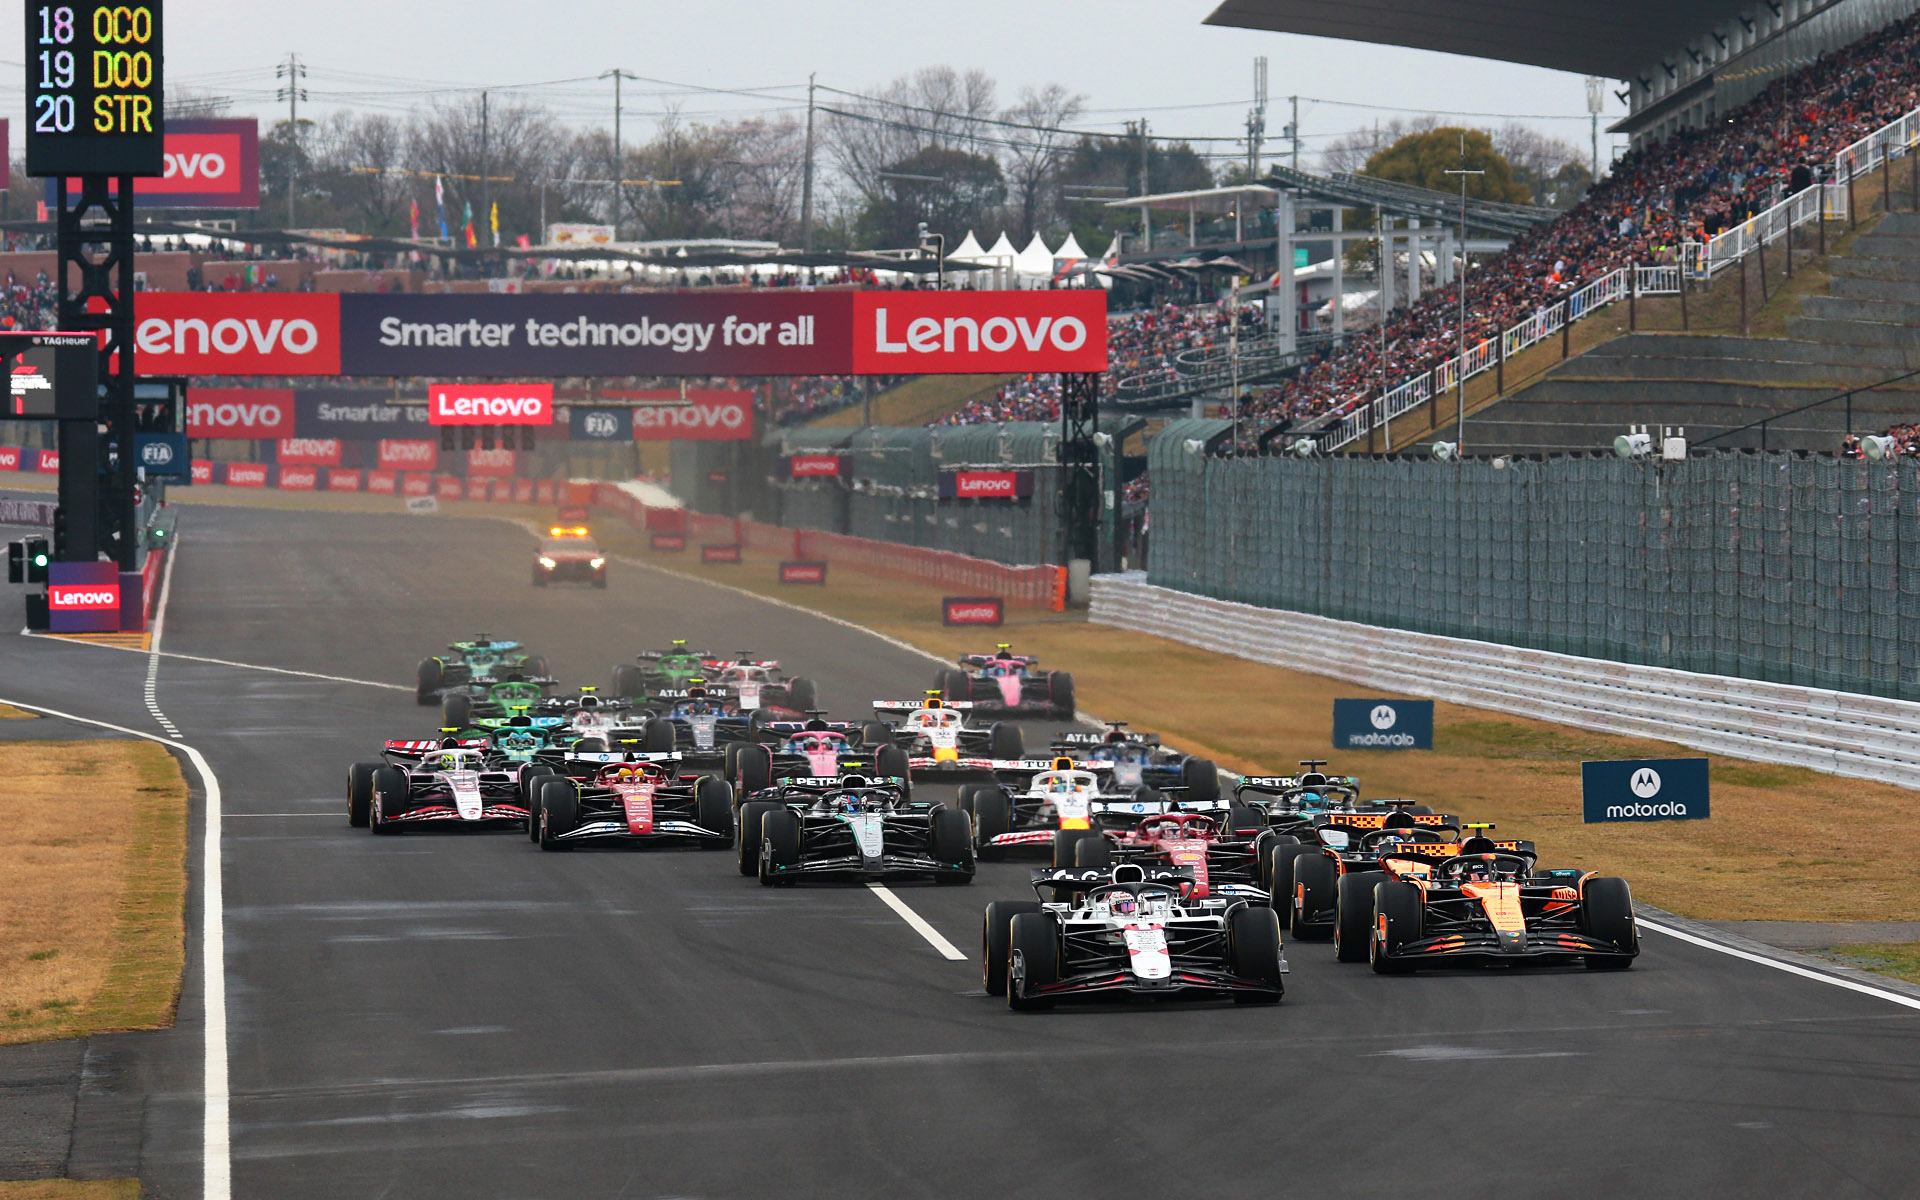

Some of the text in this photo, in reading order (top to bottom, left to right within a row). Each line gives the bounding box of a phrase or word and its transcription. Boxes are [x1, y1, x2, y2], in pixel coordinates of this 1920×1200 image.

[39, 6, 151, 44] 18 OCO
[39, 50, 152, 88] 19 DOO
[35, 94, 152, 132] 20 STR
[380, 315, 814, 352] Smarter technology for all
[876, 308, 1087, 353] Lenovo
[438, 393, 542, 416] Lenovo
[586, 417, 615, 432] FIA
[145, 447, 169, 460] FIA
[961, 477, 1017, 490] Lenovo
[54, 591, 114, 605] Lenovo
[1350, 733, 1415, 746] motorola
[1606, 802, 1687, 817] motorola
